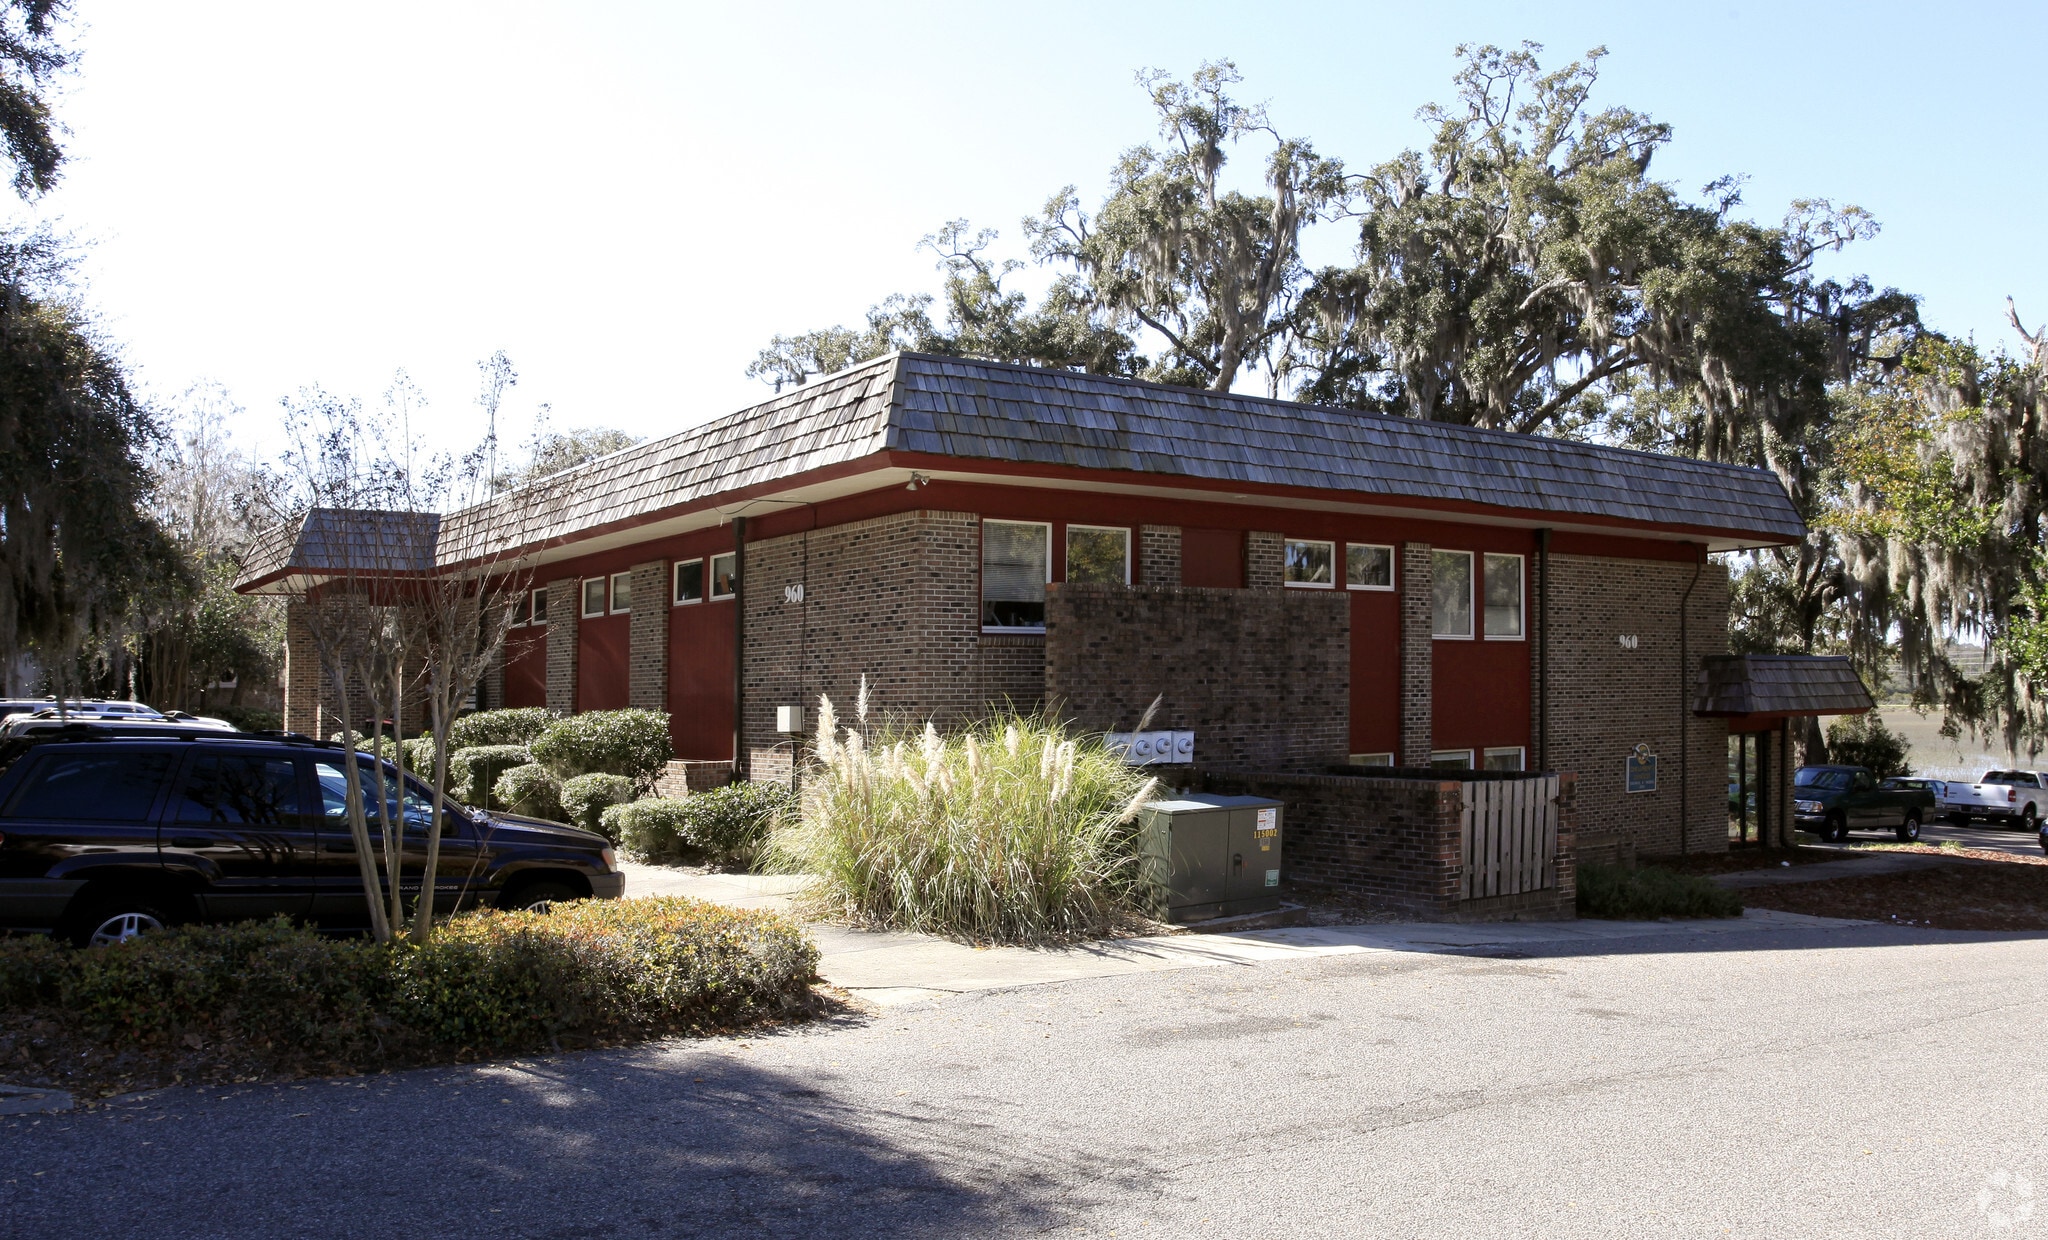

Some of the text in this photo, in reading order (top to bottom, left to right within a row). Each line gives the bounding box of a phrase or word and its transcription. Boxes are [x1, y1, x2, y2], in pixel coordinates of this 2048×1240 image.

[784, 584, 804, 603] 960
[1620, 635, 1638, 648] 960
[1253, 828, 1278, 839] 115002
